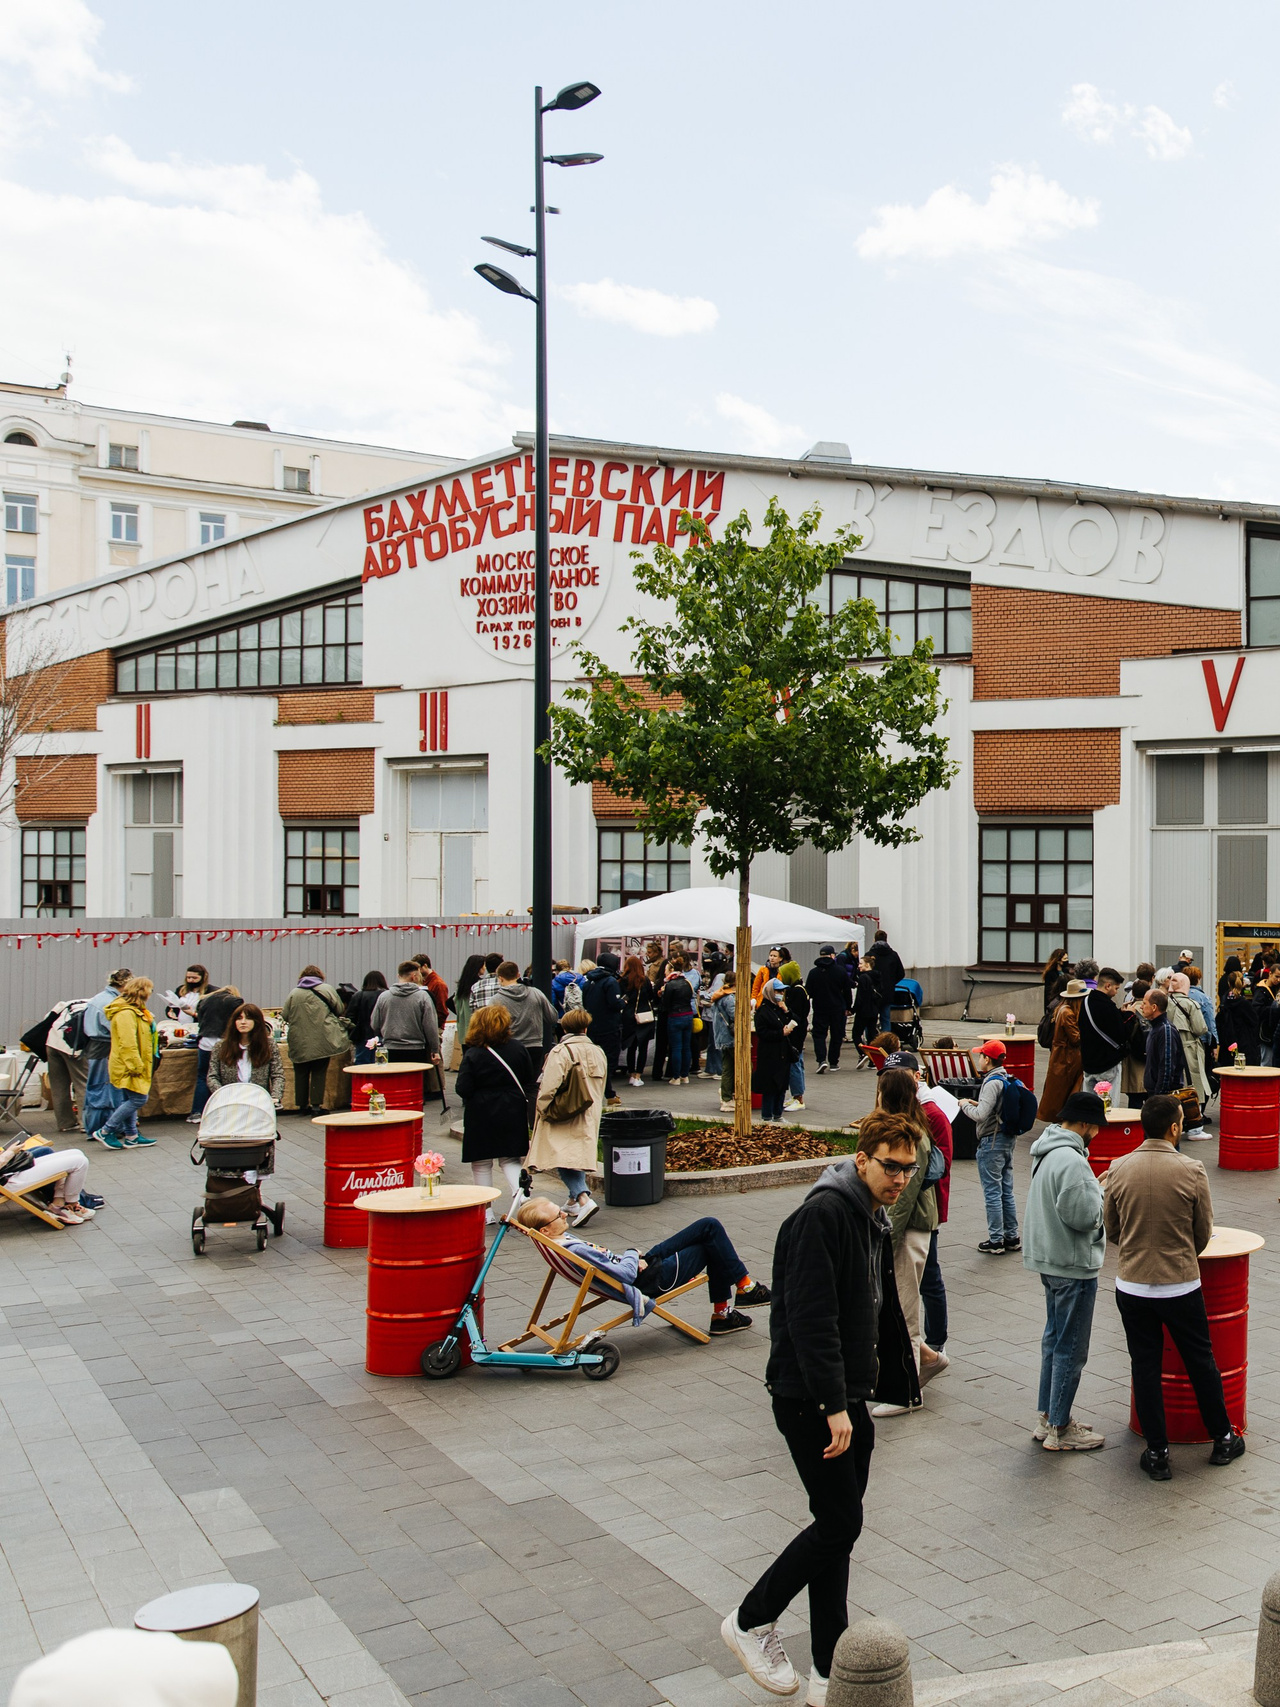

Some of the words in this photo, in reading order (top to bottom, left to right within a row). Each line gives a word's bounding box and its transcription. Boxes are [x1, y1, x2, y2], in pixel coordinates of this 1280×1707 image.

[361, 495, 602, 584] АВТОБУСНЫЙ
[613, 504, 719, 549] ПАРК
[476, 545, 589, 574] МОСКОСКОЕ
[460, 566, 599, 597] КОММУНЛЬНОЕ
[476, 591, 578, 617] ХОЗЯЙВО
[1201, 656, 1246, 732] V
[136, 703, 150, 759] II
[419, 691, 448, 752] III
[341, 1168, 405, 1192] Ламбада
